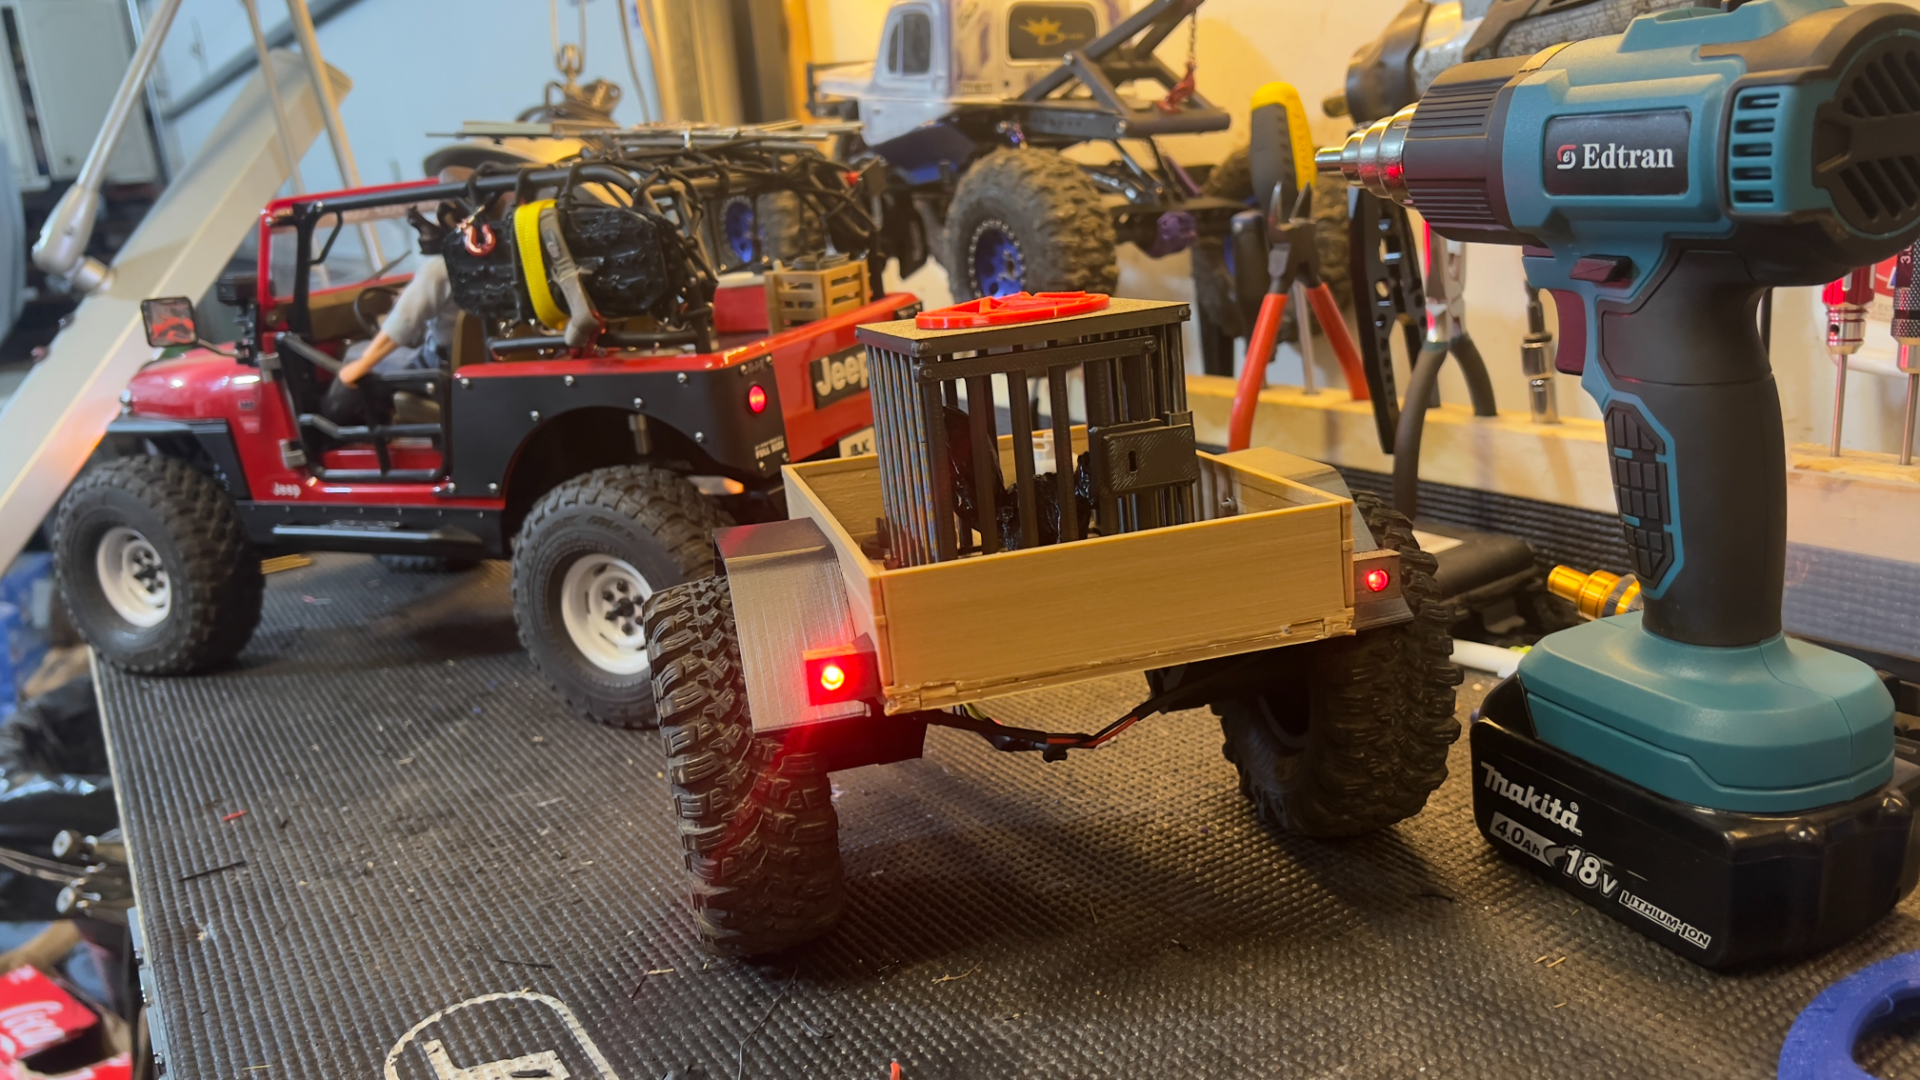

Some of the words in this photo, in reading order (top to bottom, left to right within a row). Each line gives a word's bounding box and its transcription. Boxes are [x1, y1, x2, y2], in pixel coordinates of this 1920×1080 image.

[1582, 143, 1675, 169] Edtran
[816, 351, 869, 396] Jeep
[273, 482, 301, 498] Jeep
[1494, 820, 1541, 858] 4.0Ah
